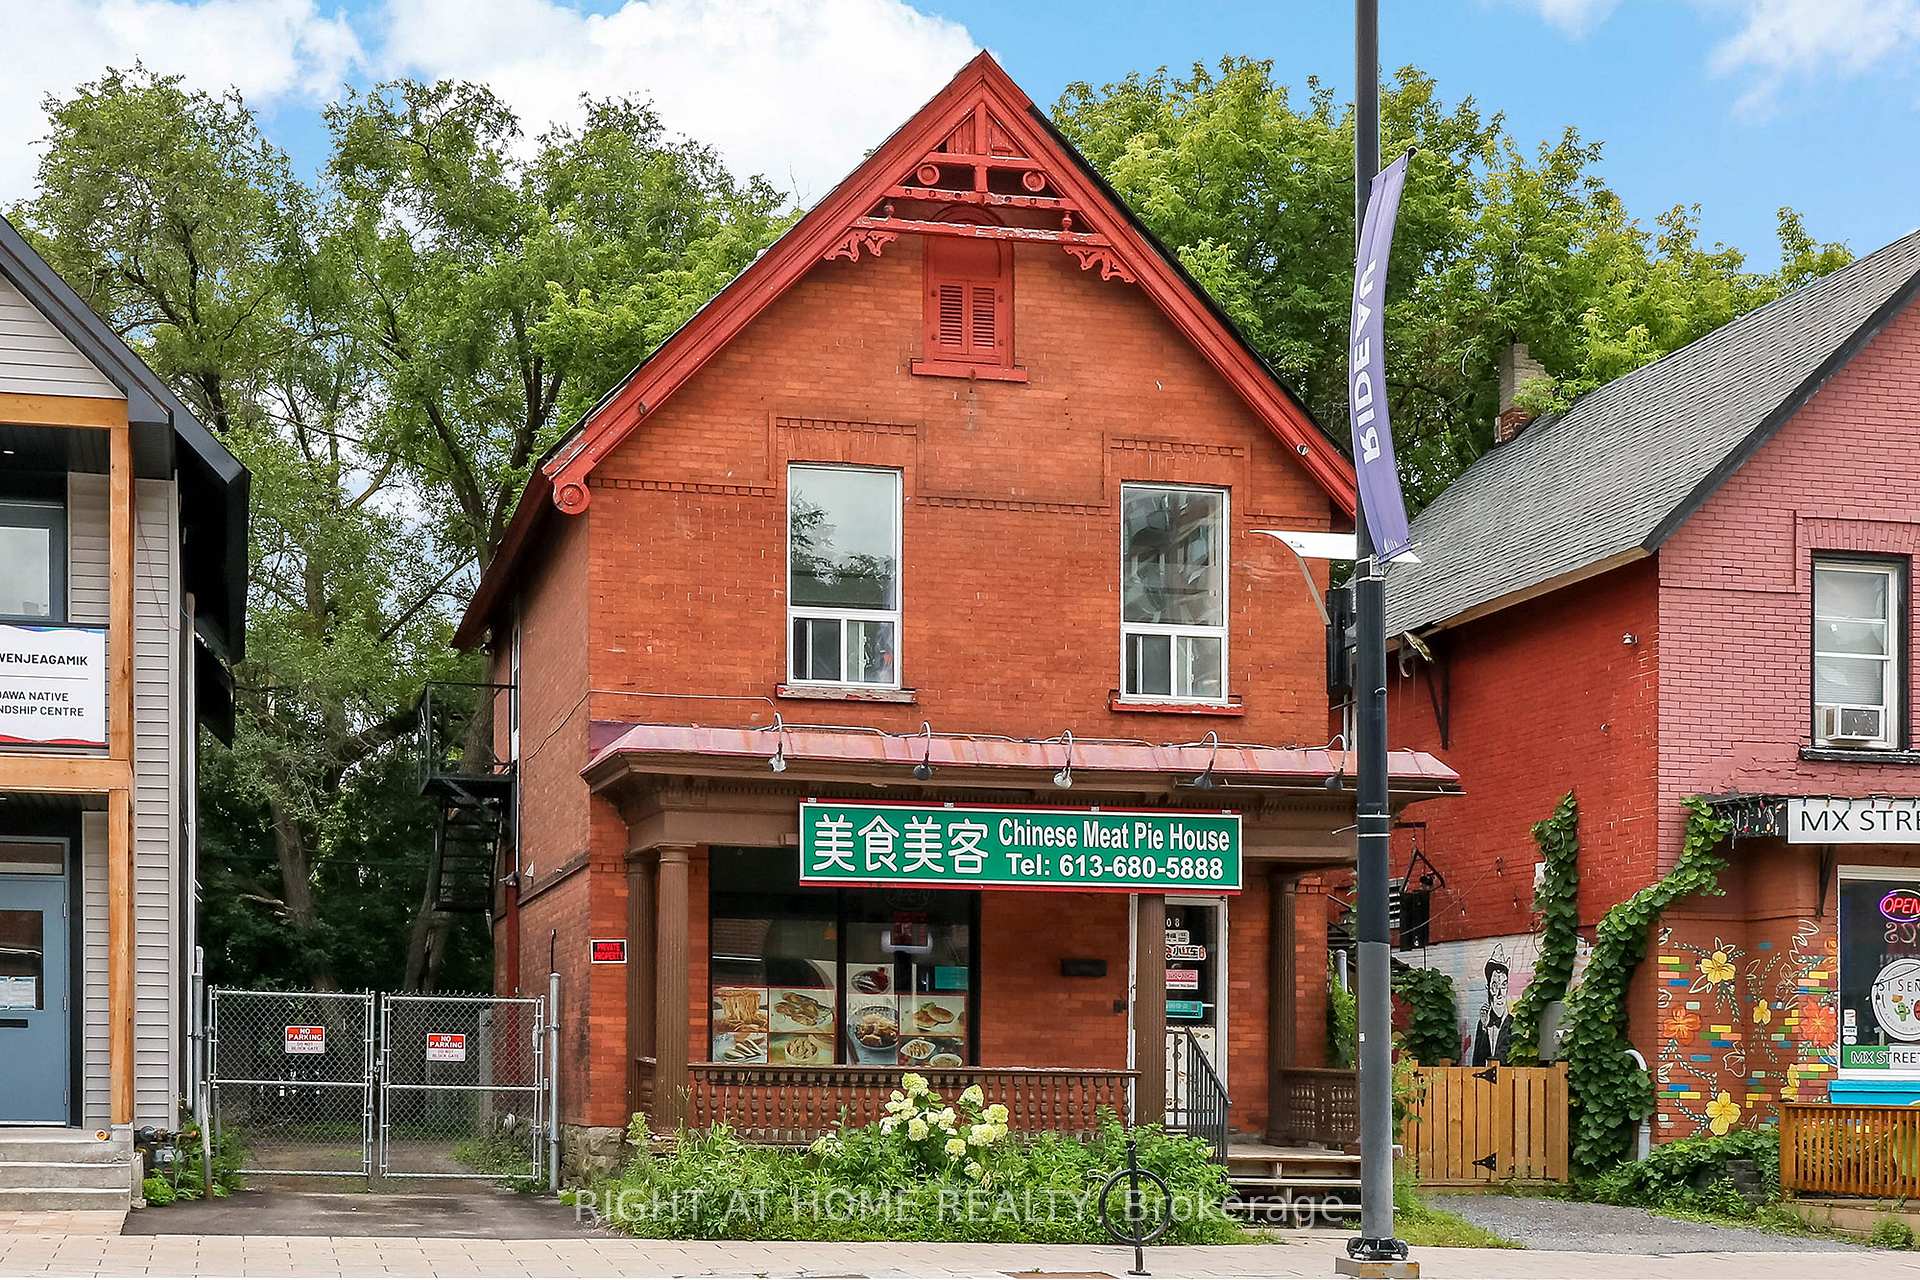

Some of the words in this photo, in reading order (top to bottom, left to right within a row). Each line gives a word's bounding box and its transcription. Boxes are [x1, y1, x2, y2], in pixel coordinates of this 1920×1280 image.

[0, 691, 26, 701] AWA
[29, 692, 69, 702] NATIVE
[40, 706, 84, 717] CENTRE
[1801, 810, 1850, 831] MX
[998, 818, 1078, 848] Chinese
[1083, 820, 1130, 849] Meat
[1134, 821, 1165, 850] Pie
[1169, 823, 1231, 851] House
[812, 814, 989, 874] 美食美客
[1005, 853, 1051, 876] Tel:
[1059, 854, 1224, 880] 613-680-5888
[1883, 898, 1920, 913] OPEN
[1852, 1051, 1874, 1063] MX
